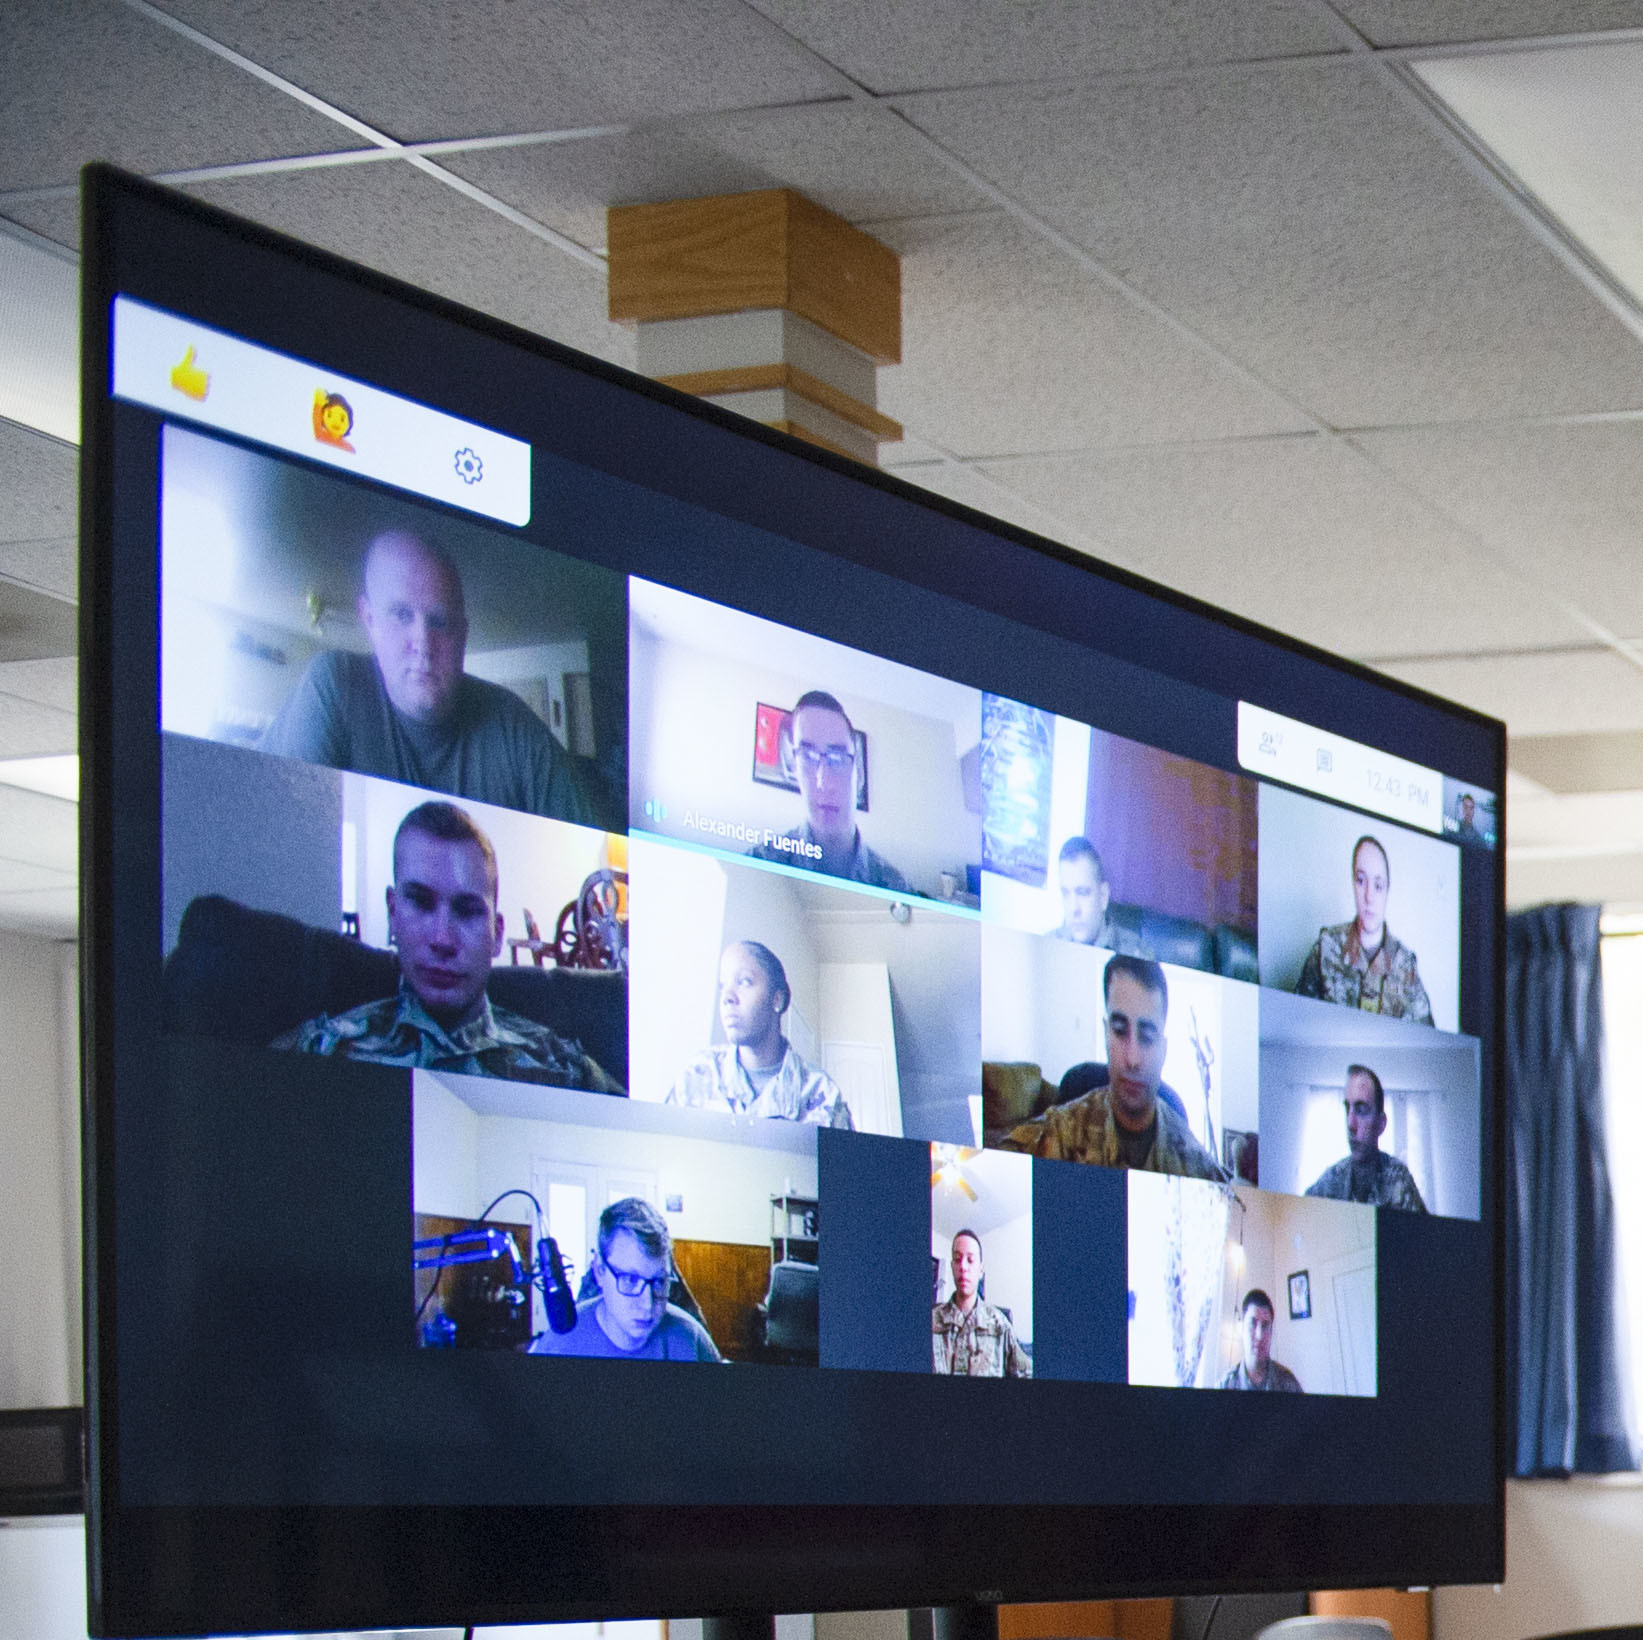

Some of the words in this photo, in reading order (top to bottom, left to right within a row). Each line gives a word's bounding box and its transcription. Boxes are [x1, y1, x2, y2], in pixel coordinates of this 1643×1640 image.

[1407, 783, 1431, 808] PM
[683, 810, 760, 844] Alexander
[763, 829, 823, 860] Fuentes
